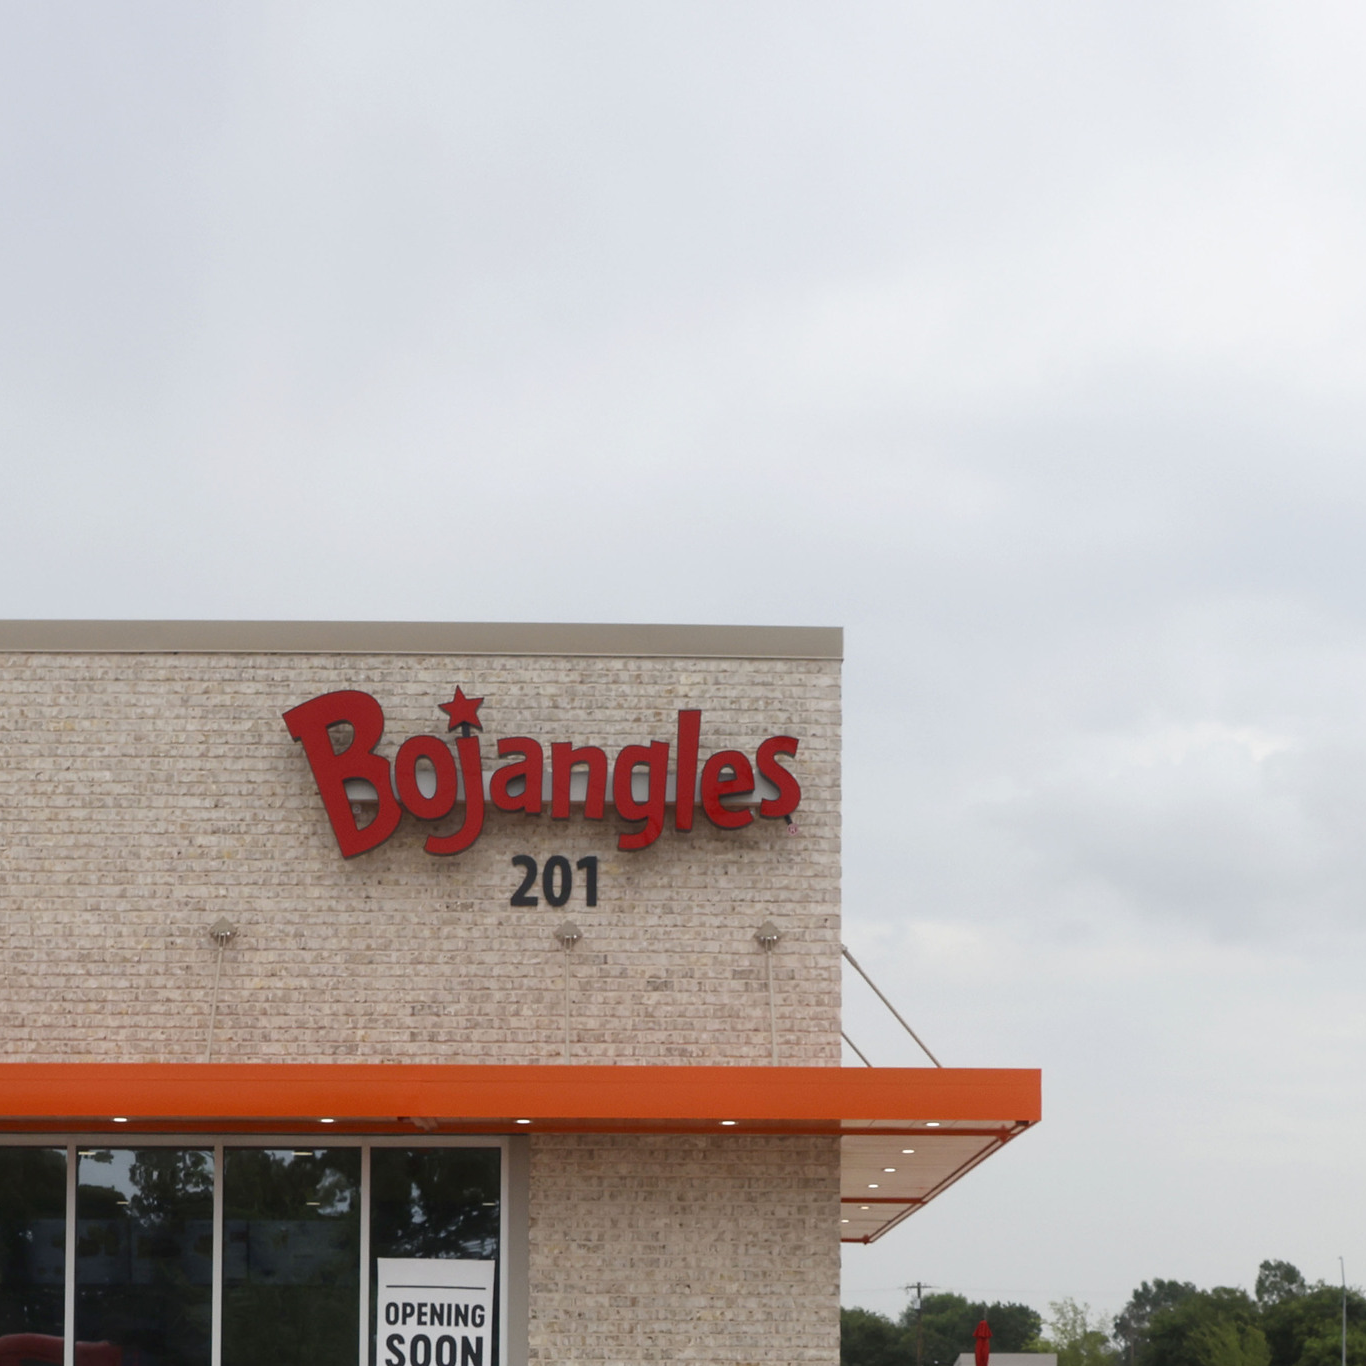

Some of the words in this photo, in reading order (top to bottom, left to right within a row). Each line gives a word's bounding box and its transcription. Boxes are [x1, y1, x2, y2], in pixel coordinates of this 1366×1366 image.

[281, 685, 802, 860] Bojangles
[510, 855, 598, 908] 201
[385, 1302, 485, 1328] OPENING
